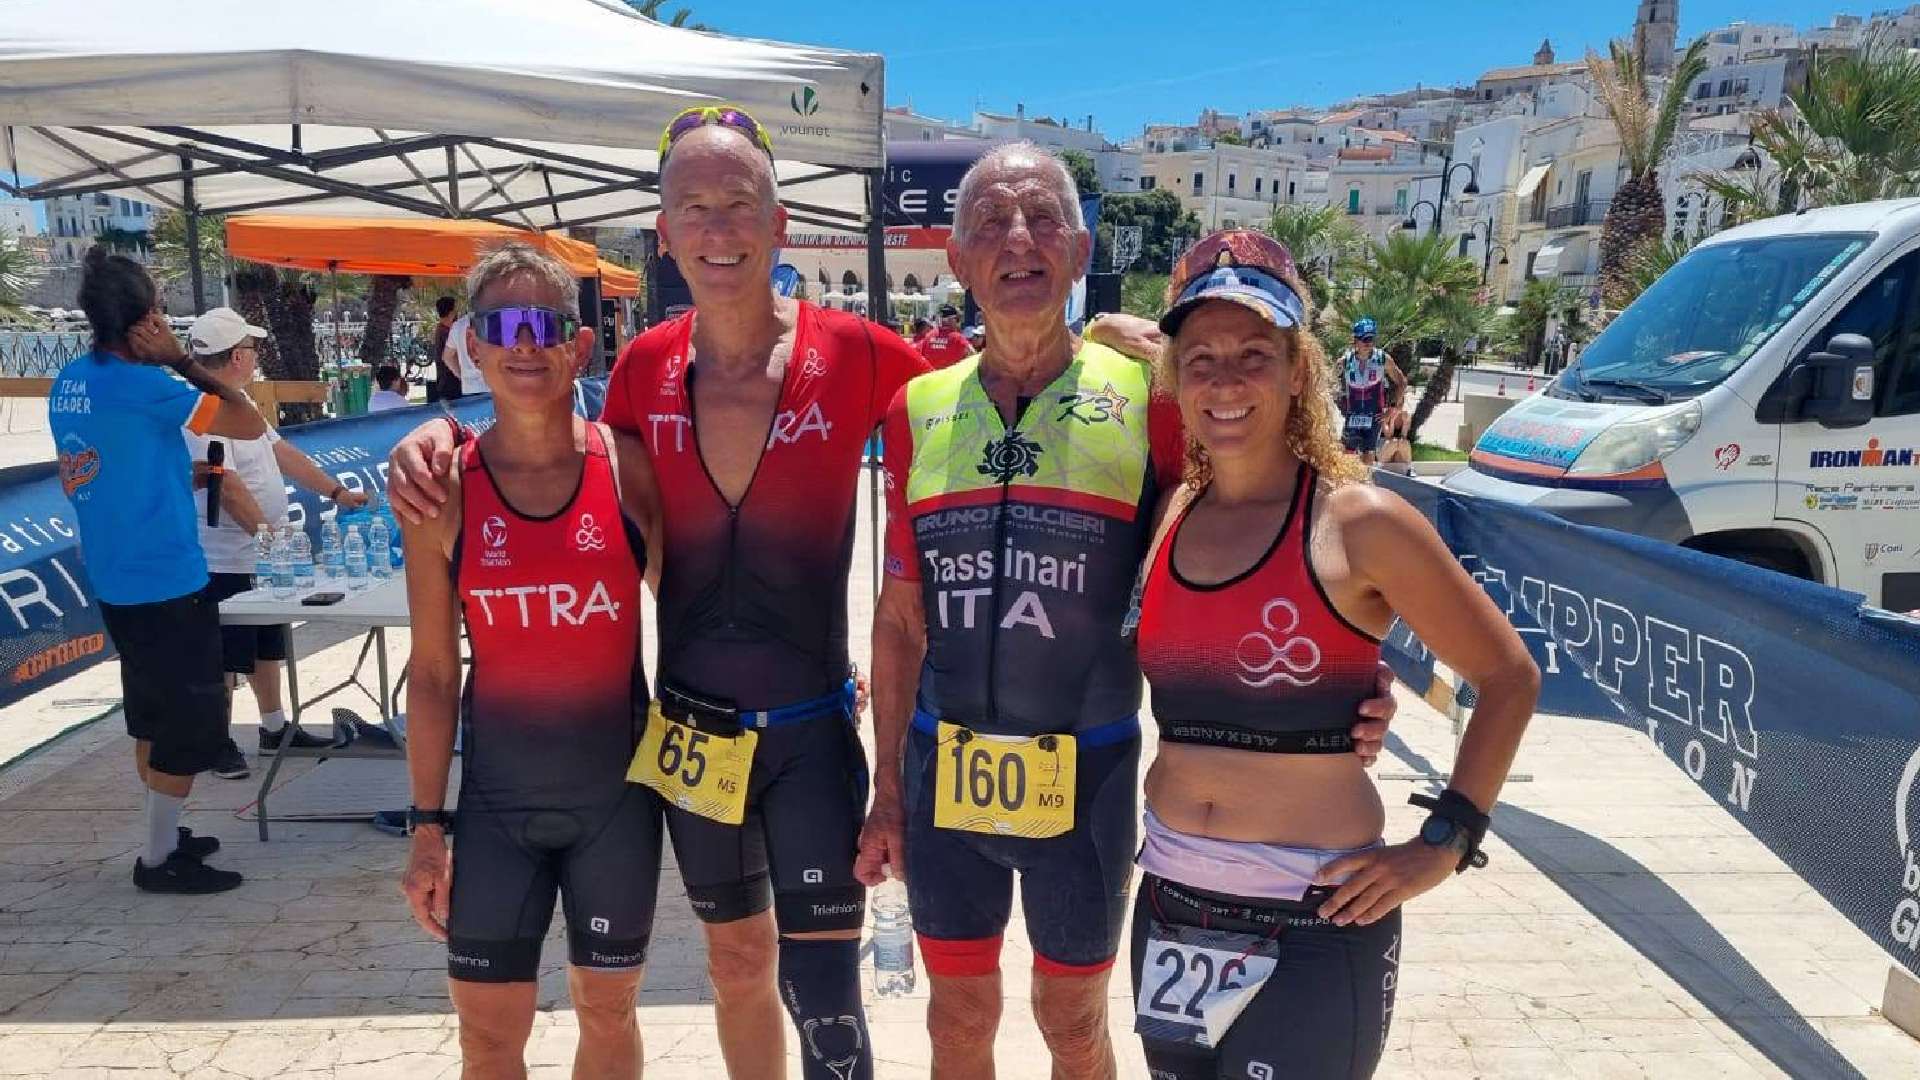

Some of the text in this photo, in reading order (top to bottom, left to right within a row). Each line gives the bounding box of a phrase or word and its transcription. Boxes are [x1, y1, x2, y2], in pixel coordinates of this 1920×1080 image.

[61, 380, 86, 396] TEAM
[52, 397, 91, 414] LEADER
[1810, 438, 1913, 467] IRONMAN
[917, 508, 991, 533] BRUNO
[657, 725, 709, 787] 65
[952, 746, 1026, 811] 160
[1038, 793, 1065, 808] M9
